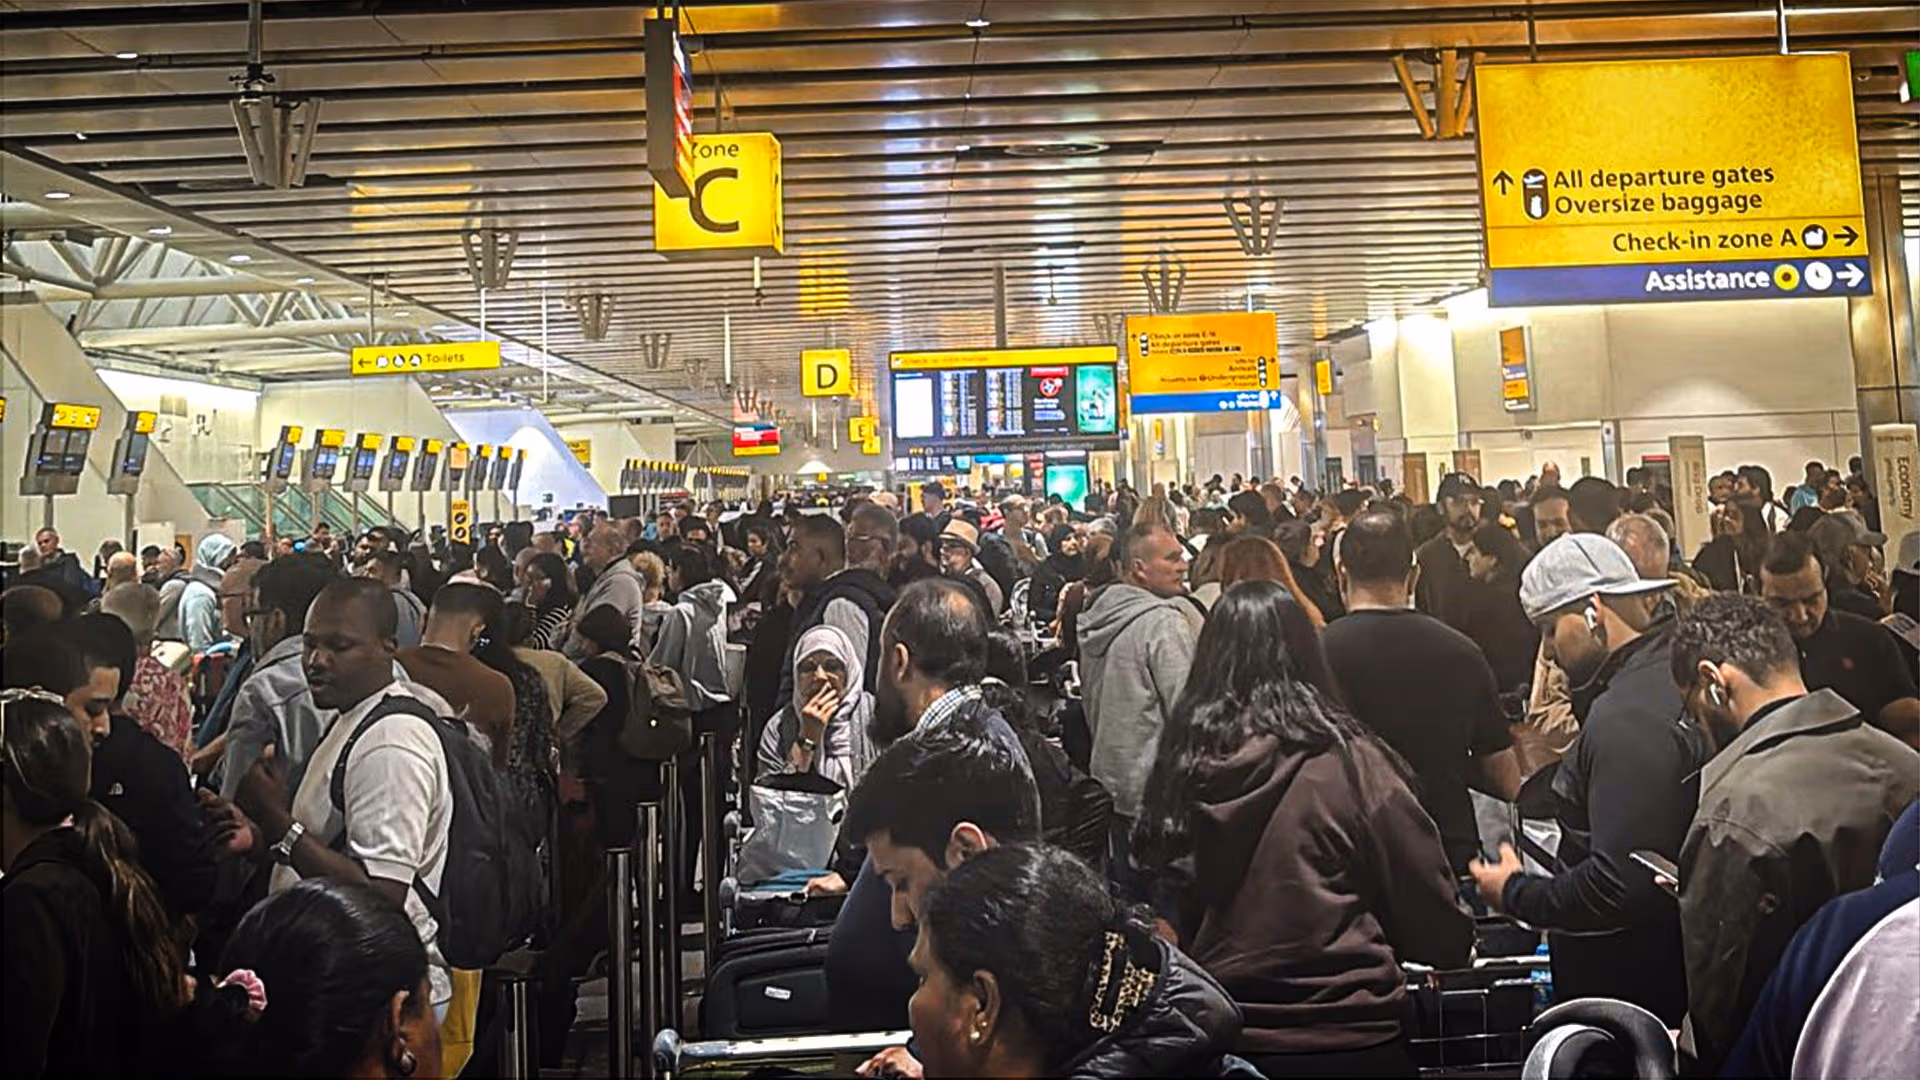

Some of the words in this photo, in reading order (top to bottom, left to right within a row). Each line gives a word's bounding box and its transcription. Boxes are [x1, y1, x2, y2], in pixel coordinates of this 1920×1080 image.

[1553, 169, 1583, 188] All
[1590, 167, 1705, 190] departure
[1711, 166, 1774, 188] gates
[689, 167, 740, 233] C
[1555, 193, 1654, 214] Oversize
[1661, 193, 1762, 214] baggage
[1613, 230, 1710, 251] Check-in
[1717, 234, 1773, 249] zone
[1780, 228, 1798, 247] A
[1645, 268, 1770, 292] Assistance
[425, 353, 465, 364] Toilets
[817, 363, 838, 389] D
[1897, 456, 1914, 520] Economy
